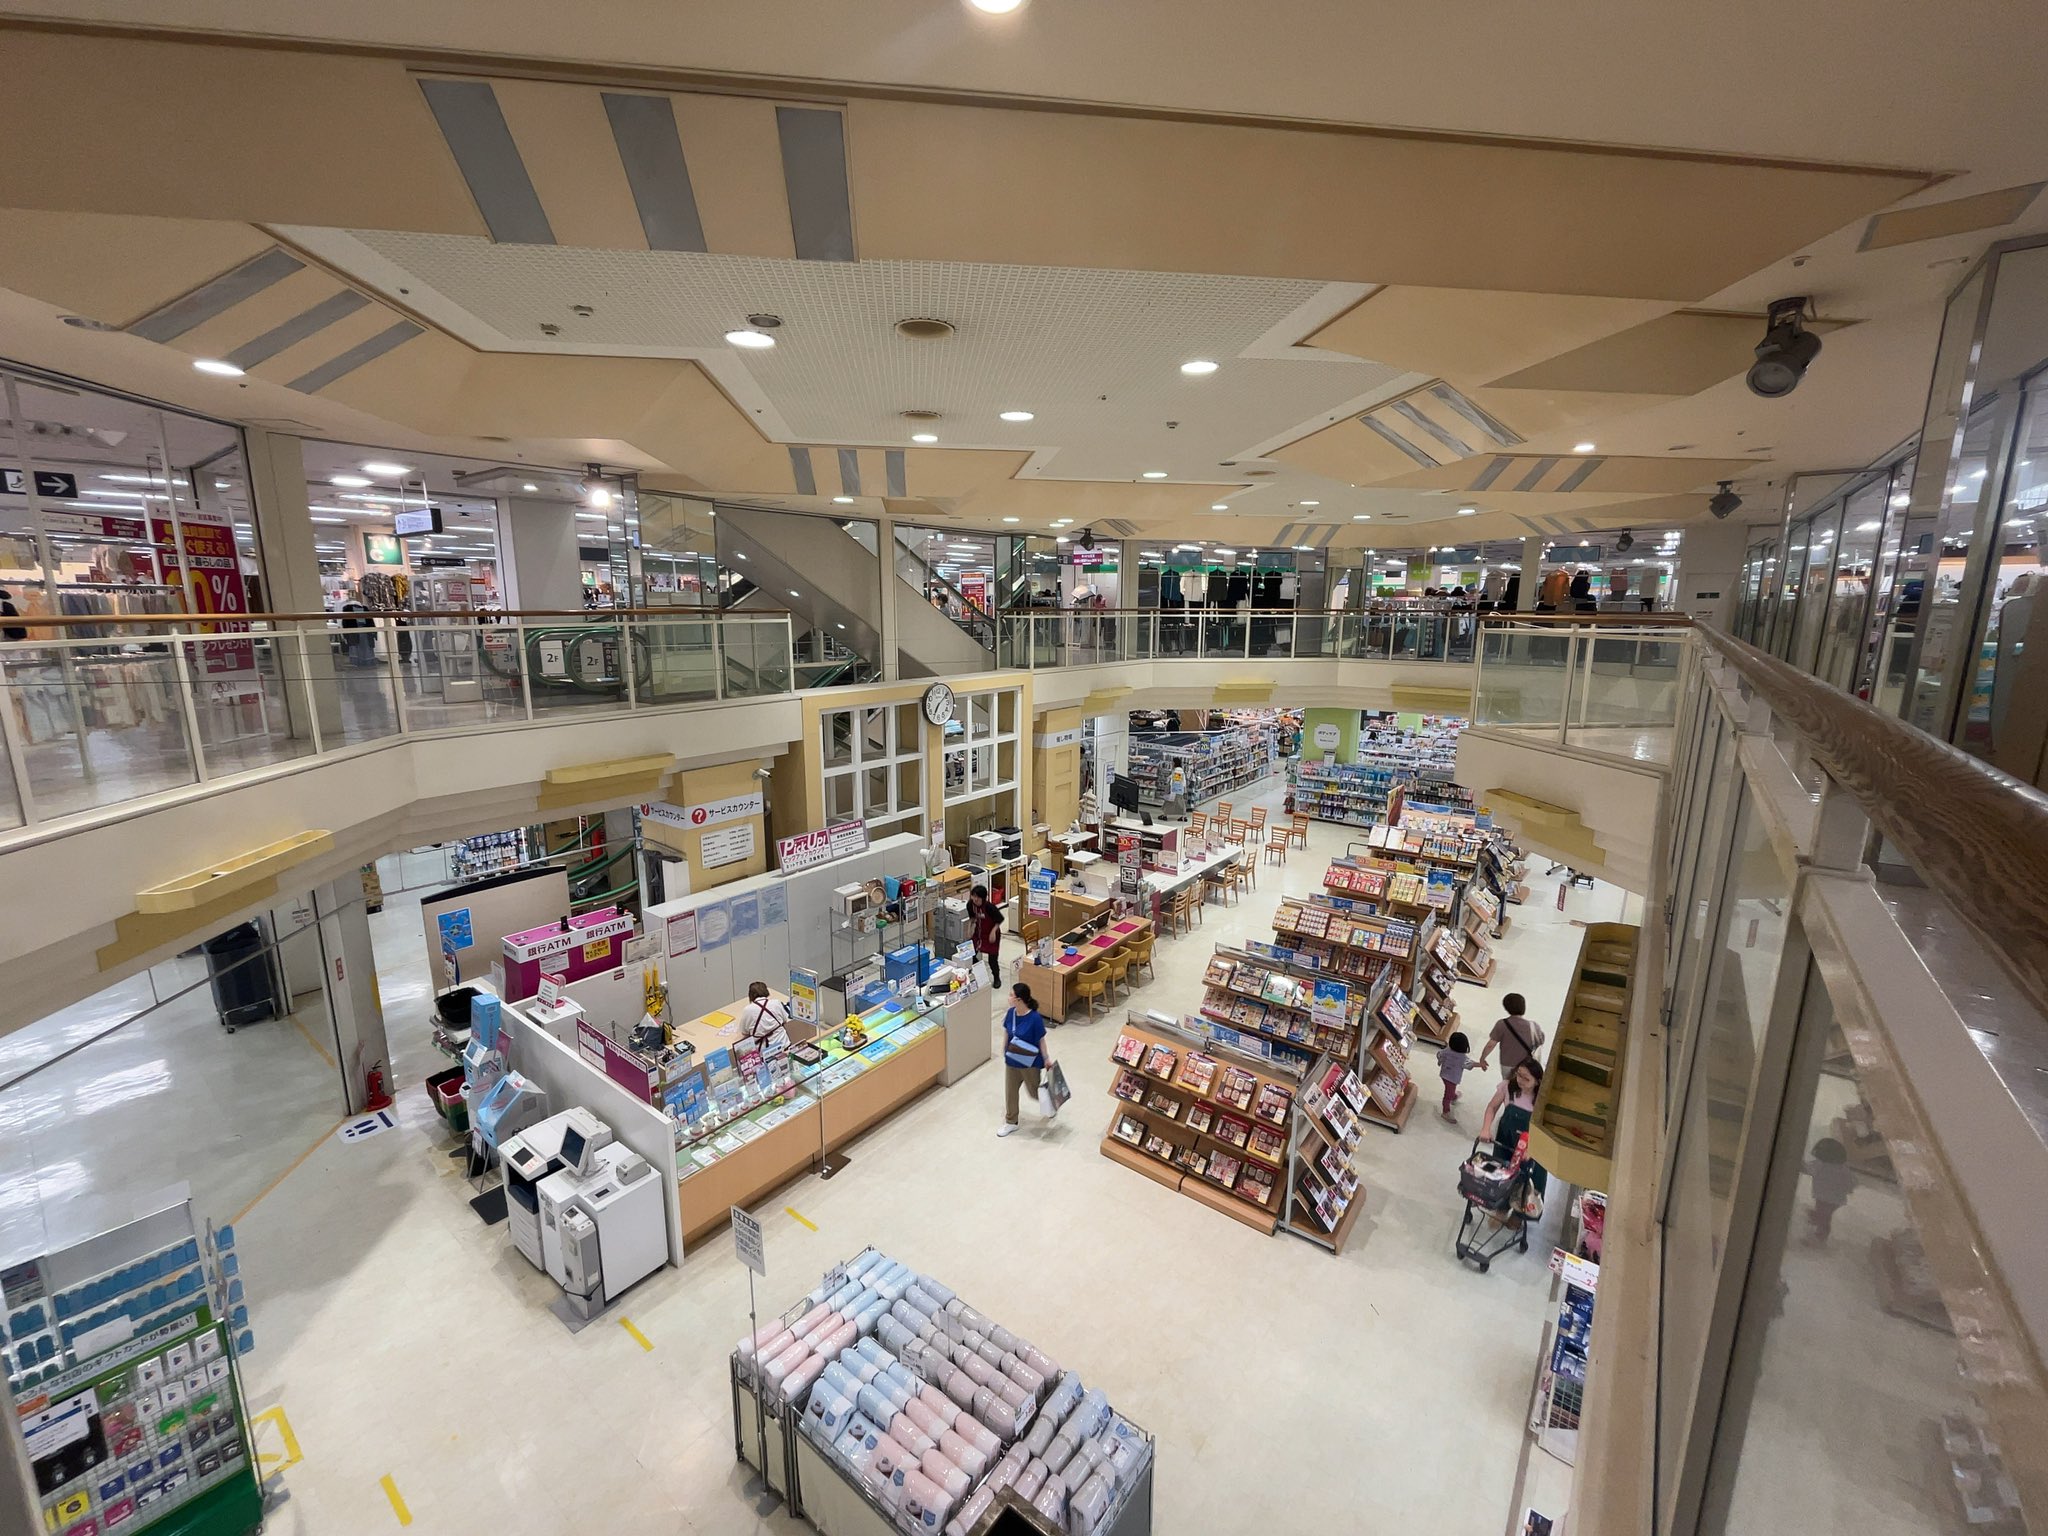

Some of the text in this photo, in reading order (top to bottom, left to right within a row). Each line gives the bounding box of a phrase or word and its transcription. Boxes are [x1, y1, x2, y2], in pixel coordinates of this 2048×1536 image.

[546, 653, 559, 663] 2F
[586, 656, 599, 666] 2F
[651, 807, 686, 822] サービスカウンター
[709, 801, 761, 818] サービスカウンター
[586, 921, 626, 939] 銀行ATM
[527, 937, 571, 957] 銀行ATM
